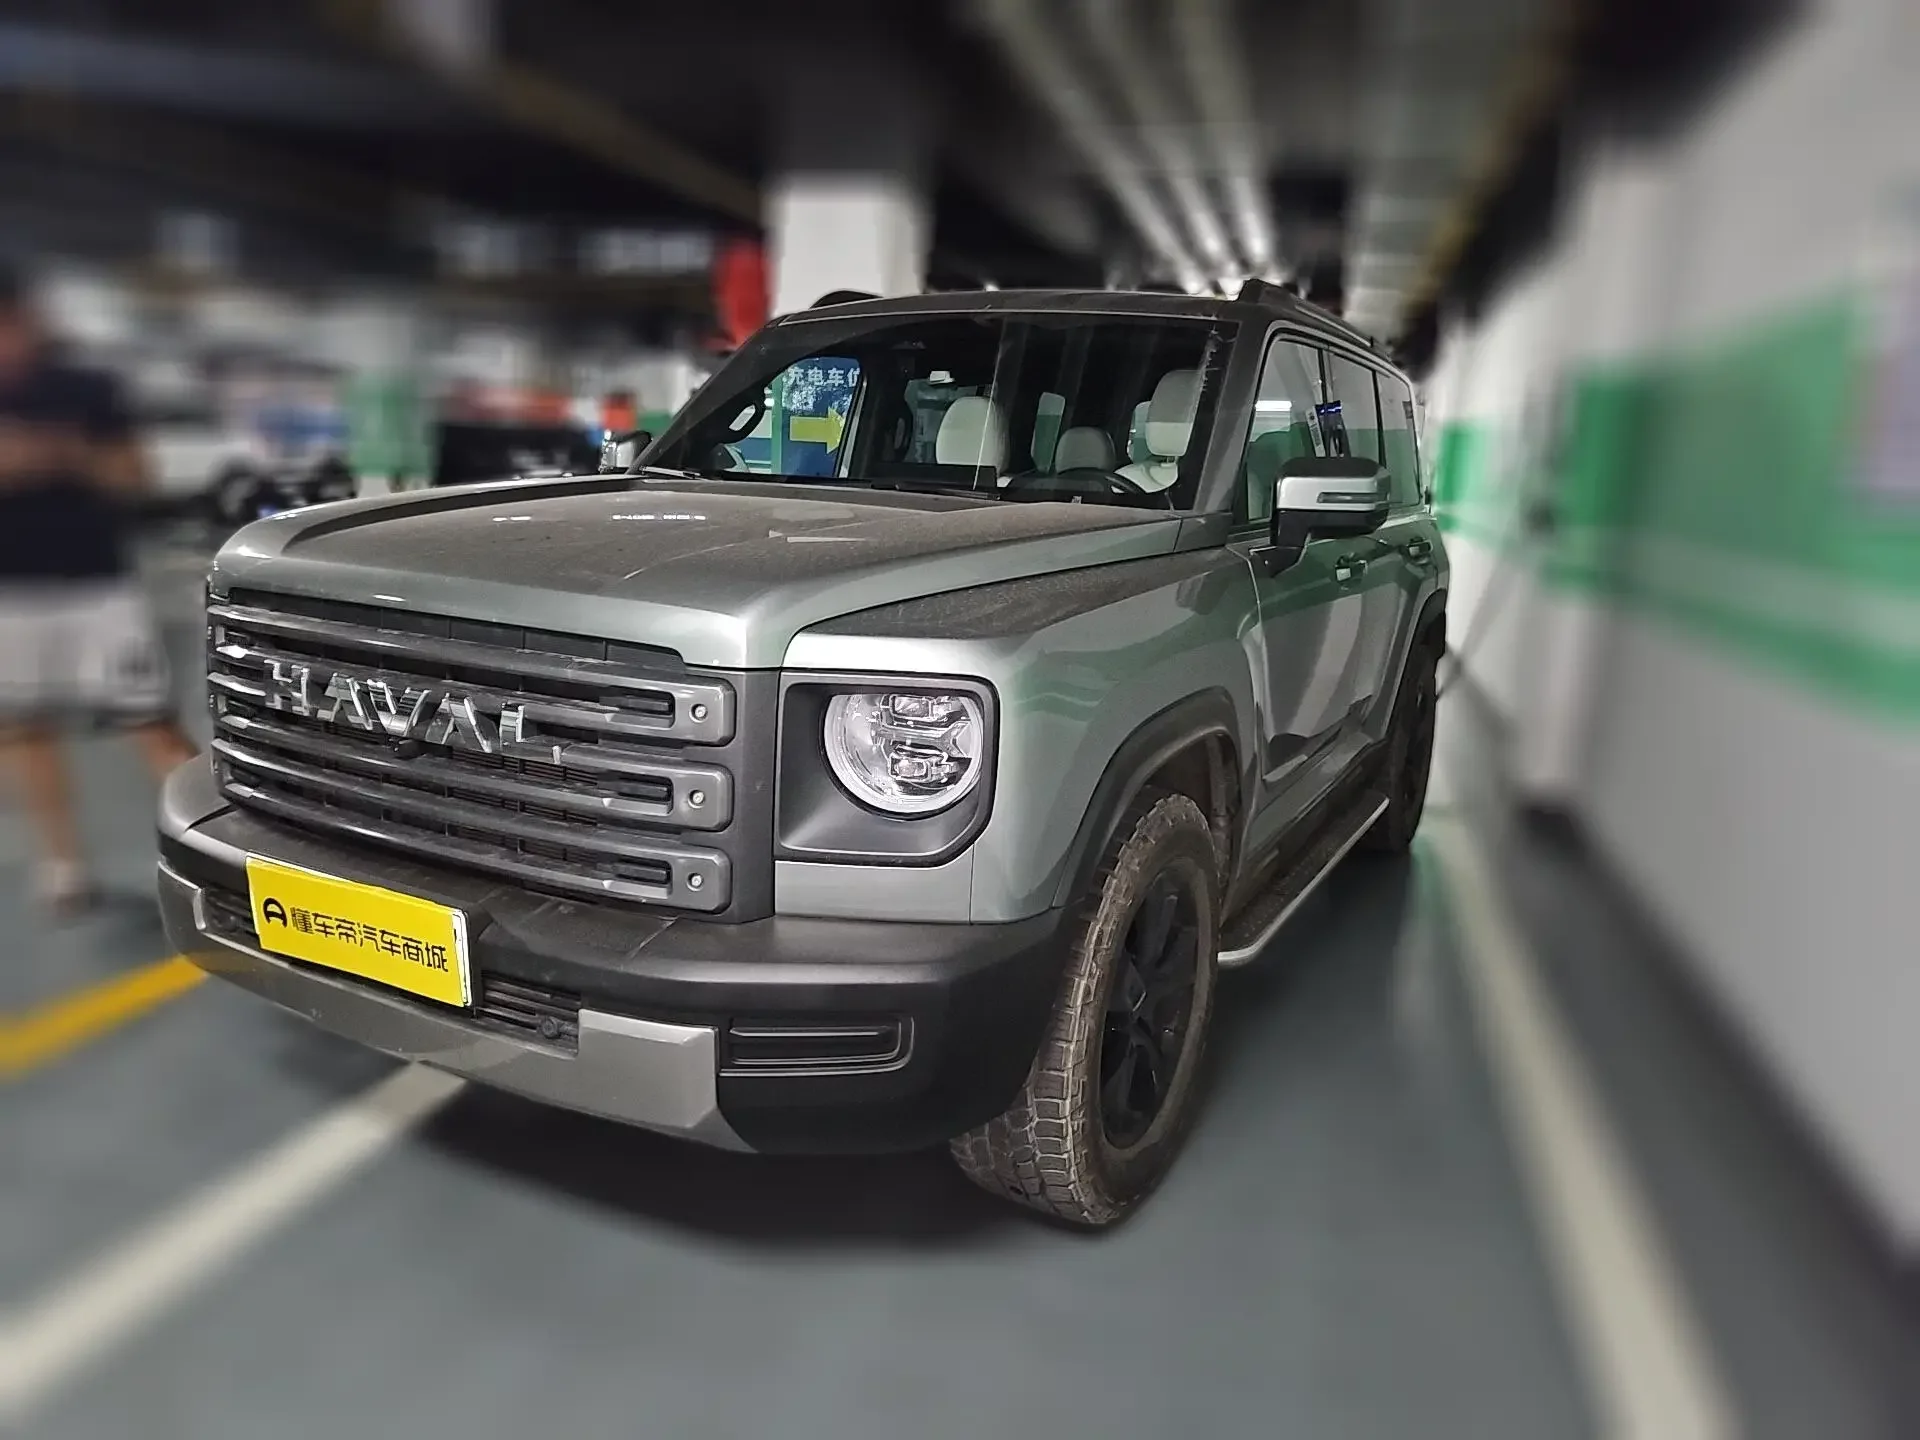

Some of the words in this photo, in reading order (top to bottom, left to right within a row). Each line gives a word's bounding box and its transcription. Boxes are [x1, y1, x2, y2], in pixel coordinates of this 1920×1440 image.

[263, 659, 562, 765] HAVAL
[290, 906, 449, 973] 懂车帝汽车商城
